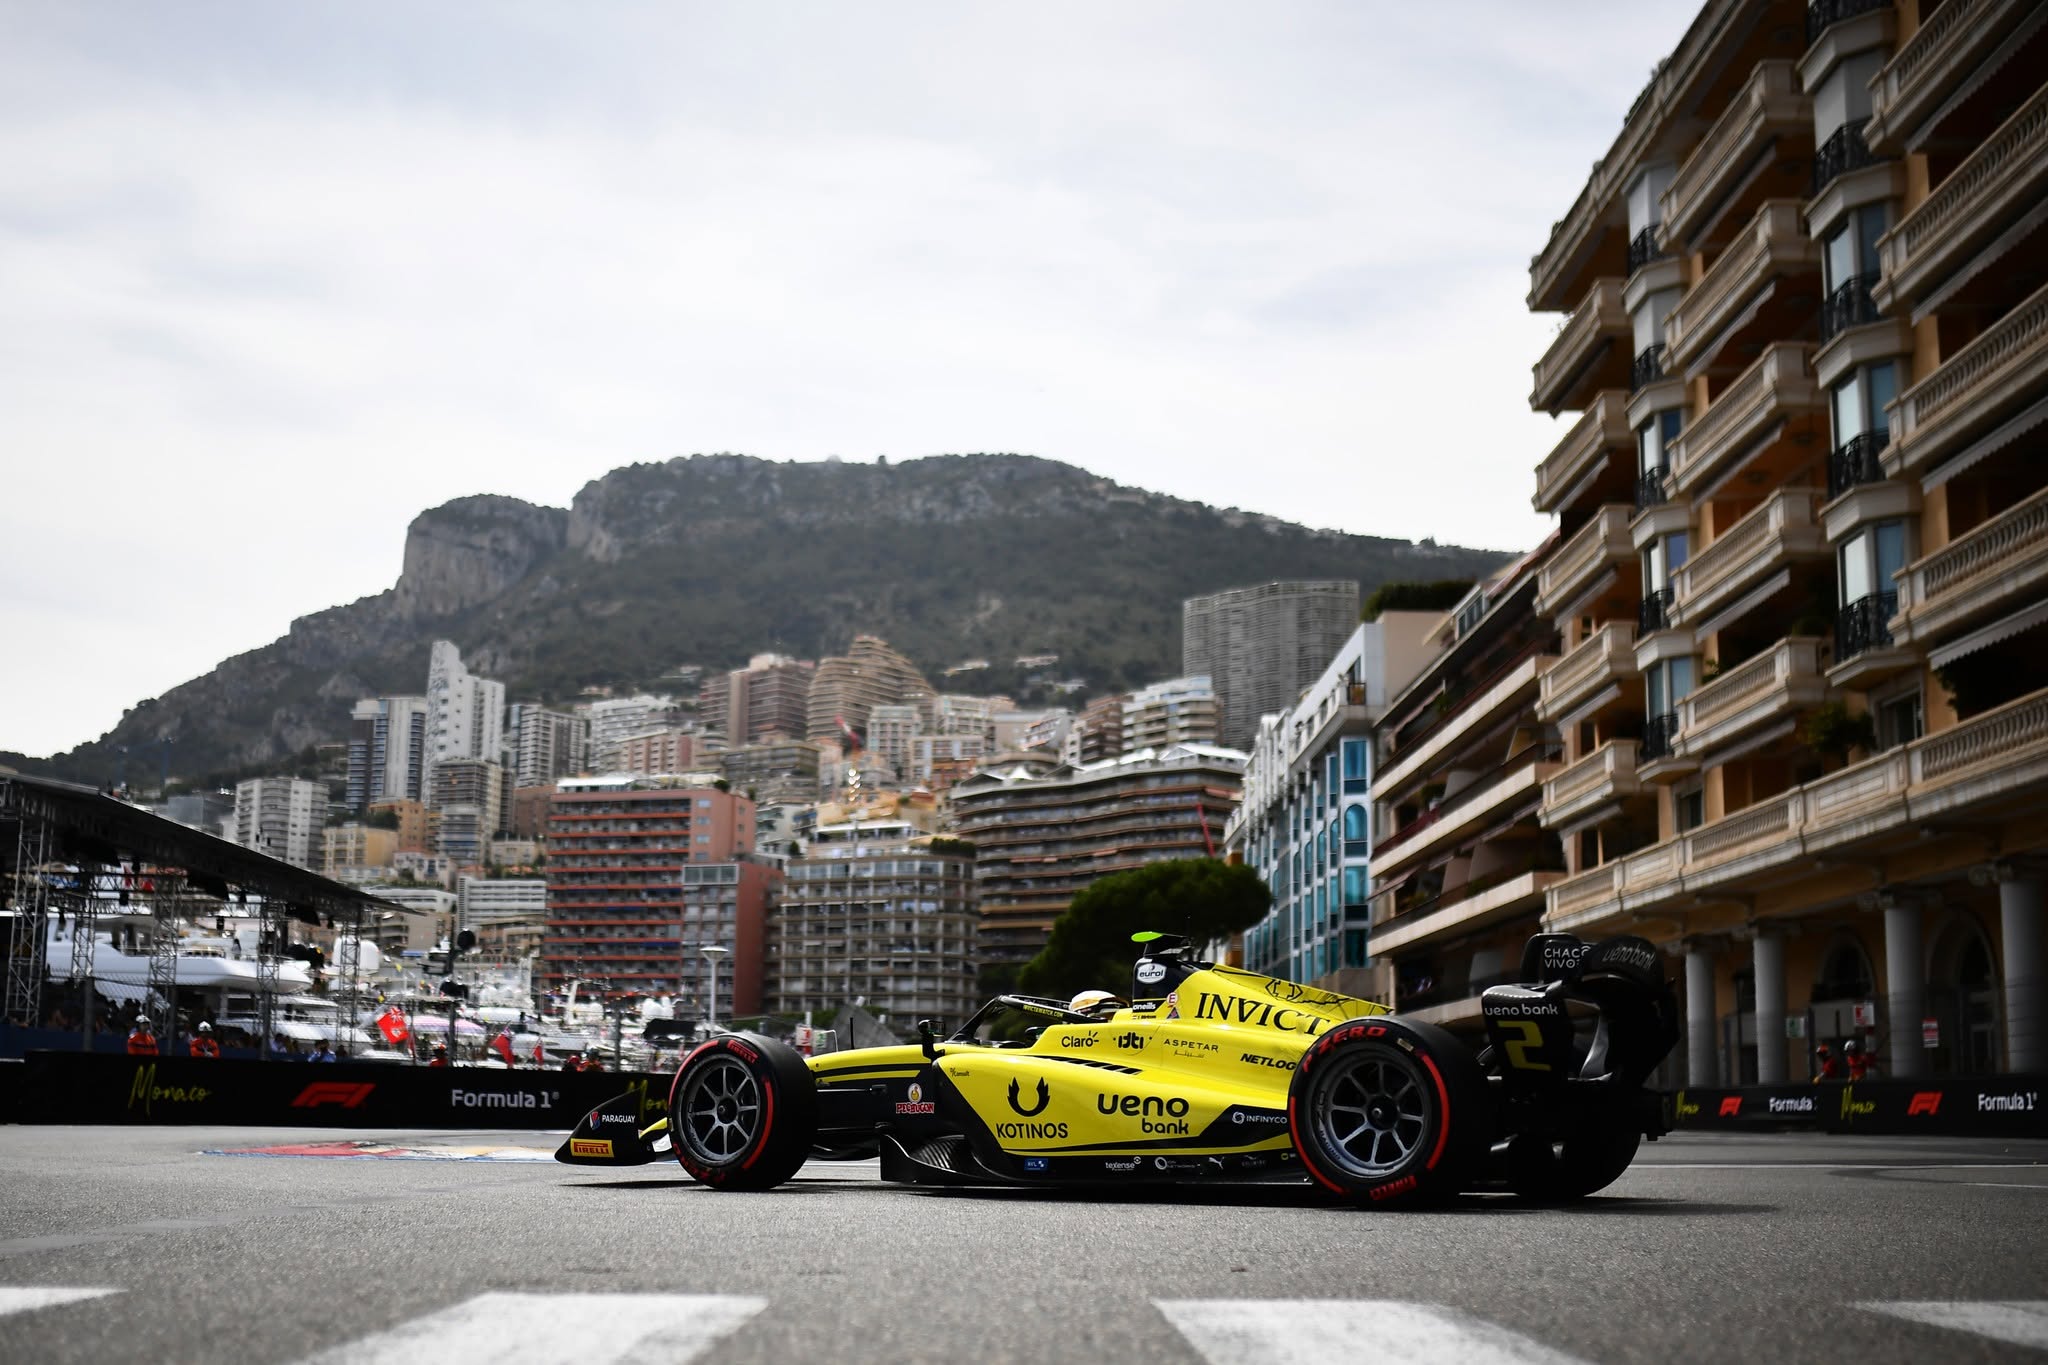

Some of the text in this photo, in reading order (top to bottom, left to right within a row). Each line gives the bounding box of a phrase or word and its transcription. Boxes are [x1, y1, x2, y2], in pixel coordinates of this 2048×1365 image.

[1139, 969, 1164, 978] eurol
[1194, 992, 1331, 1036] INVICT
[1484, 1003, 1560, 1016] ueno bank
[1061, 1033, 1096, 1048] Claro
[1163, 1038, 1219, 1053] ASPETAR
[1317, 1025, 1389, 1057] ZERO
[1496, 1019, 1553, 1073] 2
[1240, 1053, 1297, 1070] NETLOG
[128, 1063, 213, 1120] Monaco
[451, 1088, 536, 1109] Formula
[1097, 1093, 1190, 1118] ueno
[1768, 1096, 1813, 1113] Formula
[1977, 1092, 2025, 1112] Formula
[601, 1114, 636, 1124] PARAGUAY
[1141, 1118, 1190, 1134] bank
[1246, 1115, 1288, 1124] INFINYCO
[995, 1122, 1069, 1139] KOTINOS
[573, 1141, 609, 1155] PIRELLI
